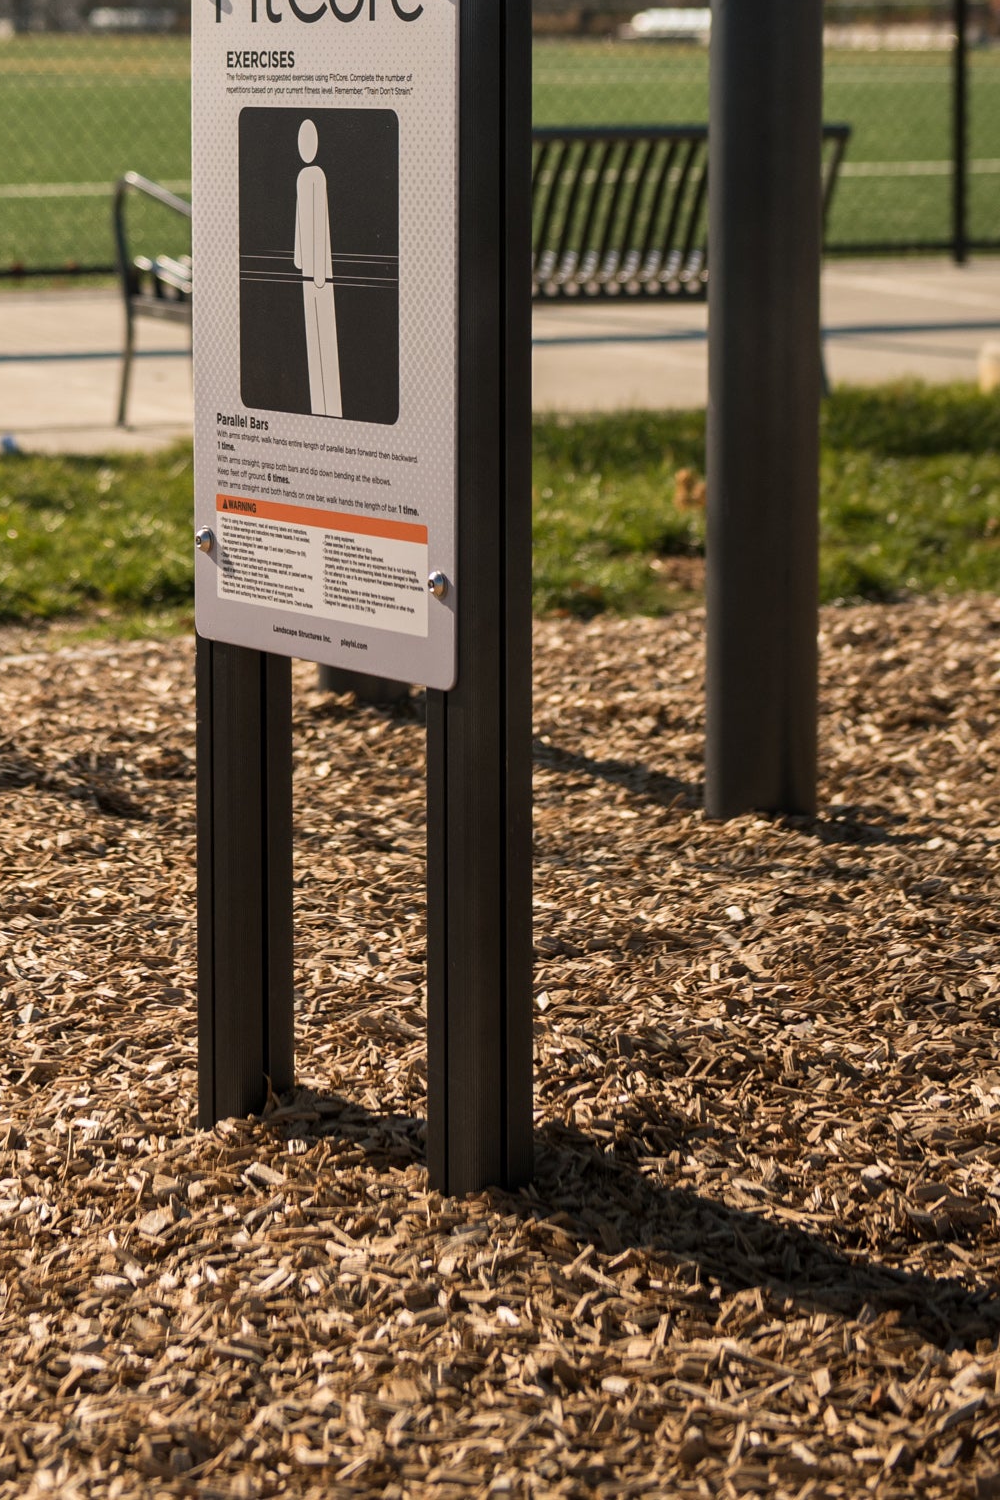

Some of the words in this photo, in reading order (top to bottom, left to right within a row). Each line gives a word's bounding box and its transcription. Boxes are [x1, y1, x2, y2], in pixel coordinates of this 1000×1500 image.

[226, 50, 295, 68] EXERCISES
[235, 73, 257, 82] following
[266, 73, 291, 82] suggested
[315, 74, 328, 83] using
[349, 73, 374, 82] Complete
[385, 74, 405, 82] number
[406, 74, 413, 82] of
[226, 87, 250, 95] repetitions
[251, 86, 266, 94] based
[304, 86, 320, 94] fitness
[216, 412, 247, 428] Parallel
[250, 417, 269, 430] Bars
[217, 429, 228, 437] With
[261, 436, 272, 444] walk
[273, 437, 287, 446] hands
[288, 439, 302, 448] entire
[303, 440, 319, 450] length
[326, 444, 344, 453] parallel
[345, 446, 356, 455] bars
[357, 448, 377, 458] forward
[378, 451, 390, 459] then
[217, 441, 221, 449] 1
[222, 441, 235, 451] time.
[217, 454, 228, 462] With
[261, 461, 275, 470] grasp
[275, 463, 287, 471] both
[288, 464, 298, 473] bars
[299, 466, 309, 474] and
[310, 467, 318, 476] dip
[319, 469, 333, 477] down
[334, 470, 354, 482] bending
[355, 474, 361, 482] at
[362, 474, 370, 483] the
[217, 467, 229, 476] Keep
[230, 468, 239, 477] feet
[267, 473, 272, 481] 6
[272, 473, 290, 484] times.
[217, 479, 228, 487] With
[241, 482, 259, 493] straight
[260, 485, 270, 494] and
[270, 487, 282, 495] both
[282, 489, 297, 498] hands
[326, 496, 337, 504] walk
[338, 497, 354, 507] hands
[355, 500, 363, 508] the
[364, 501, 380, 511] length
[381, 503, 387, 511] of
[398, 505, 402, 513] 1
[403, 505, 419, 516] time.
[228, 499, 257, 513] WARNING
[272, 624, 297, 636] Landscape
[298, 630, 322, 641] Structures
[323, 635, 332, 643] Inc.
